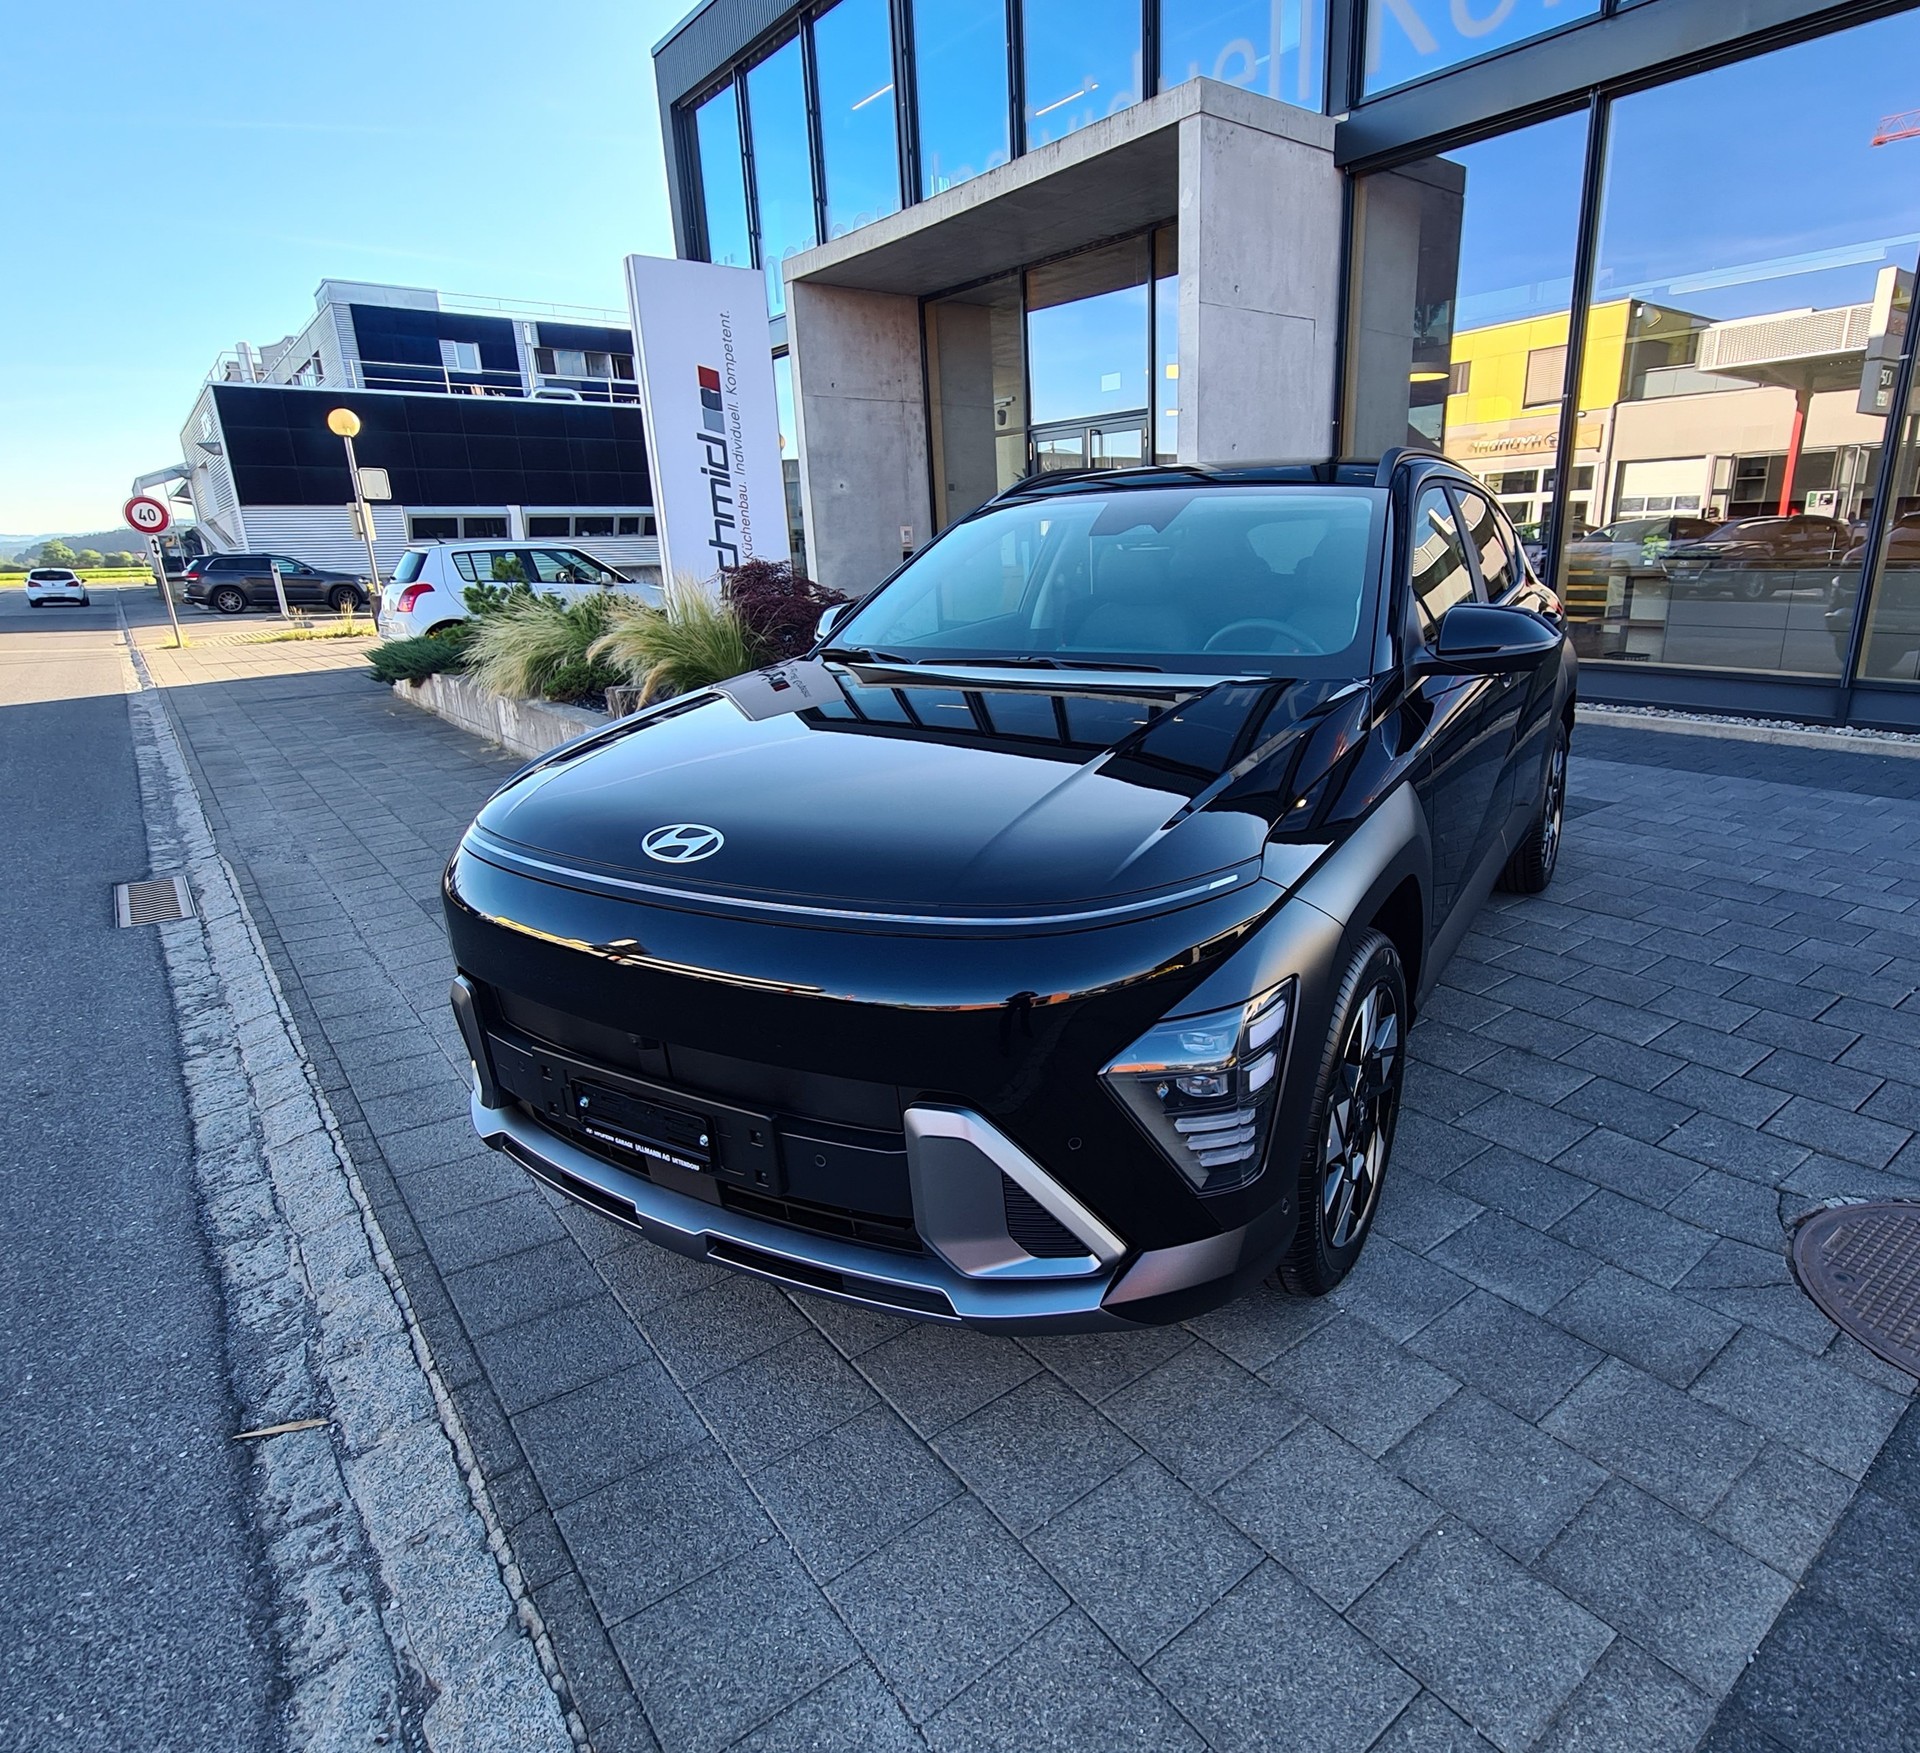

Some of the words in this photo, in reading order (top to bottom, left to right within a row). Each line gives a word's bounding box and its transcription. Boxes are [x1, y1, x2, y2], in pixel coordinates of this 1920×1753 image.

[719, 310, 738, 395] Kompetent.
[727, 401, 746, 475] Individuell.
[138, 508, 156, 521] 40
[697, 432, 739, 586] chmid
[738, 481, 753, 560] Küchenbau.
[615, 1137, 633, 1149] GARAGE
[662, 1153, 670, 1162] AG
